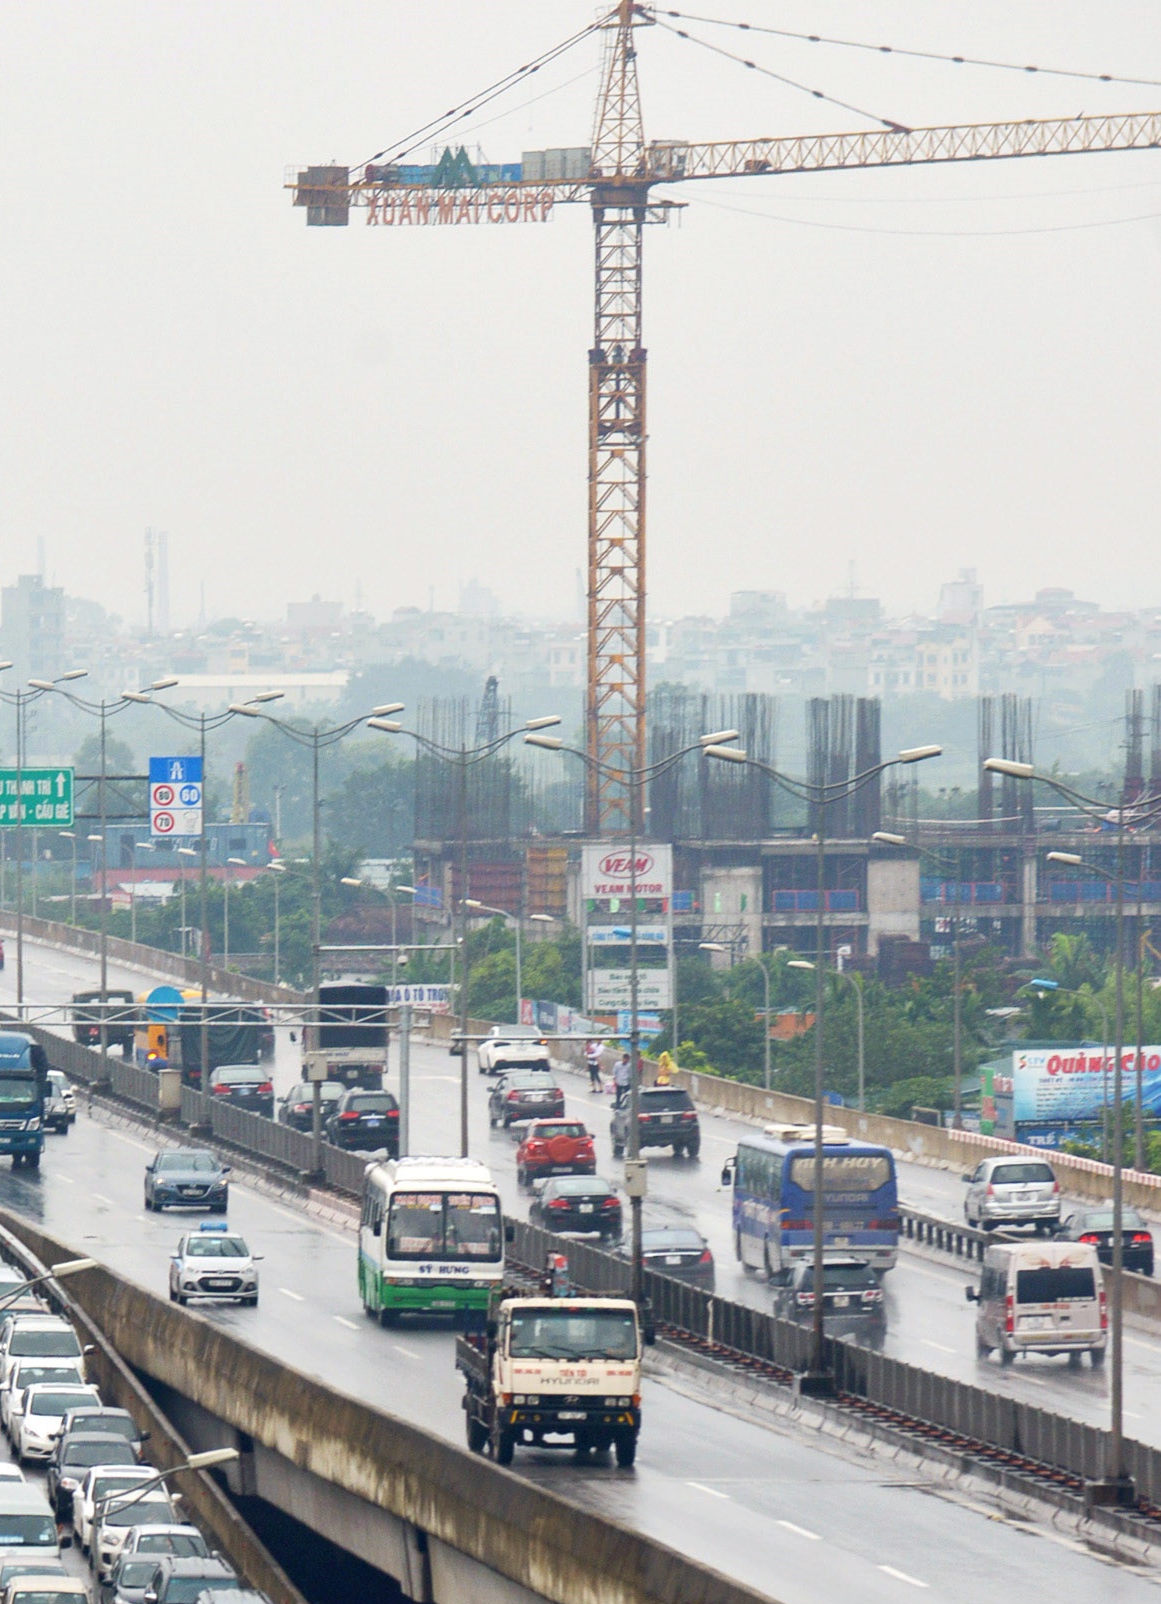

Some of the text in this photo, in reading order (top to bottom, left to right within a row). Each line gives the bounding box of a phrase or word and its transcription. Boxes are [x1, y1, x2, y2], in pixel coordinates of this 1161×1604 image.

[487, 191, 554, 223] CORP
[182, 789, 198, 802] 60
[159, 817, 170, 828] 70
[604, 858, 649, 874] VEAM
[594, 884, 625, 894] VEAM
[820, 1193, 870, 1203] YUNDAI
[540, 1377, 600, 1386] HYUNDAI
